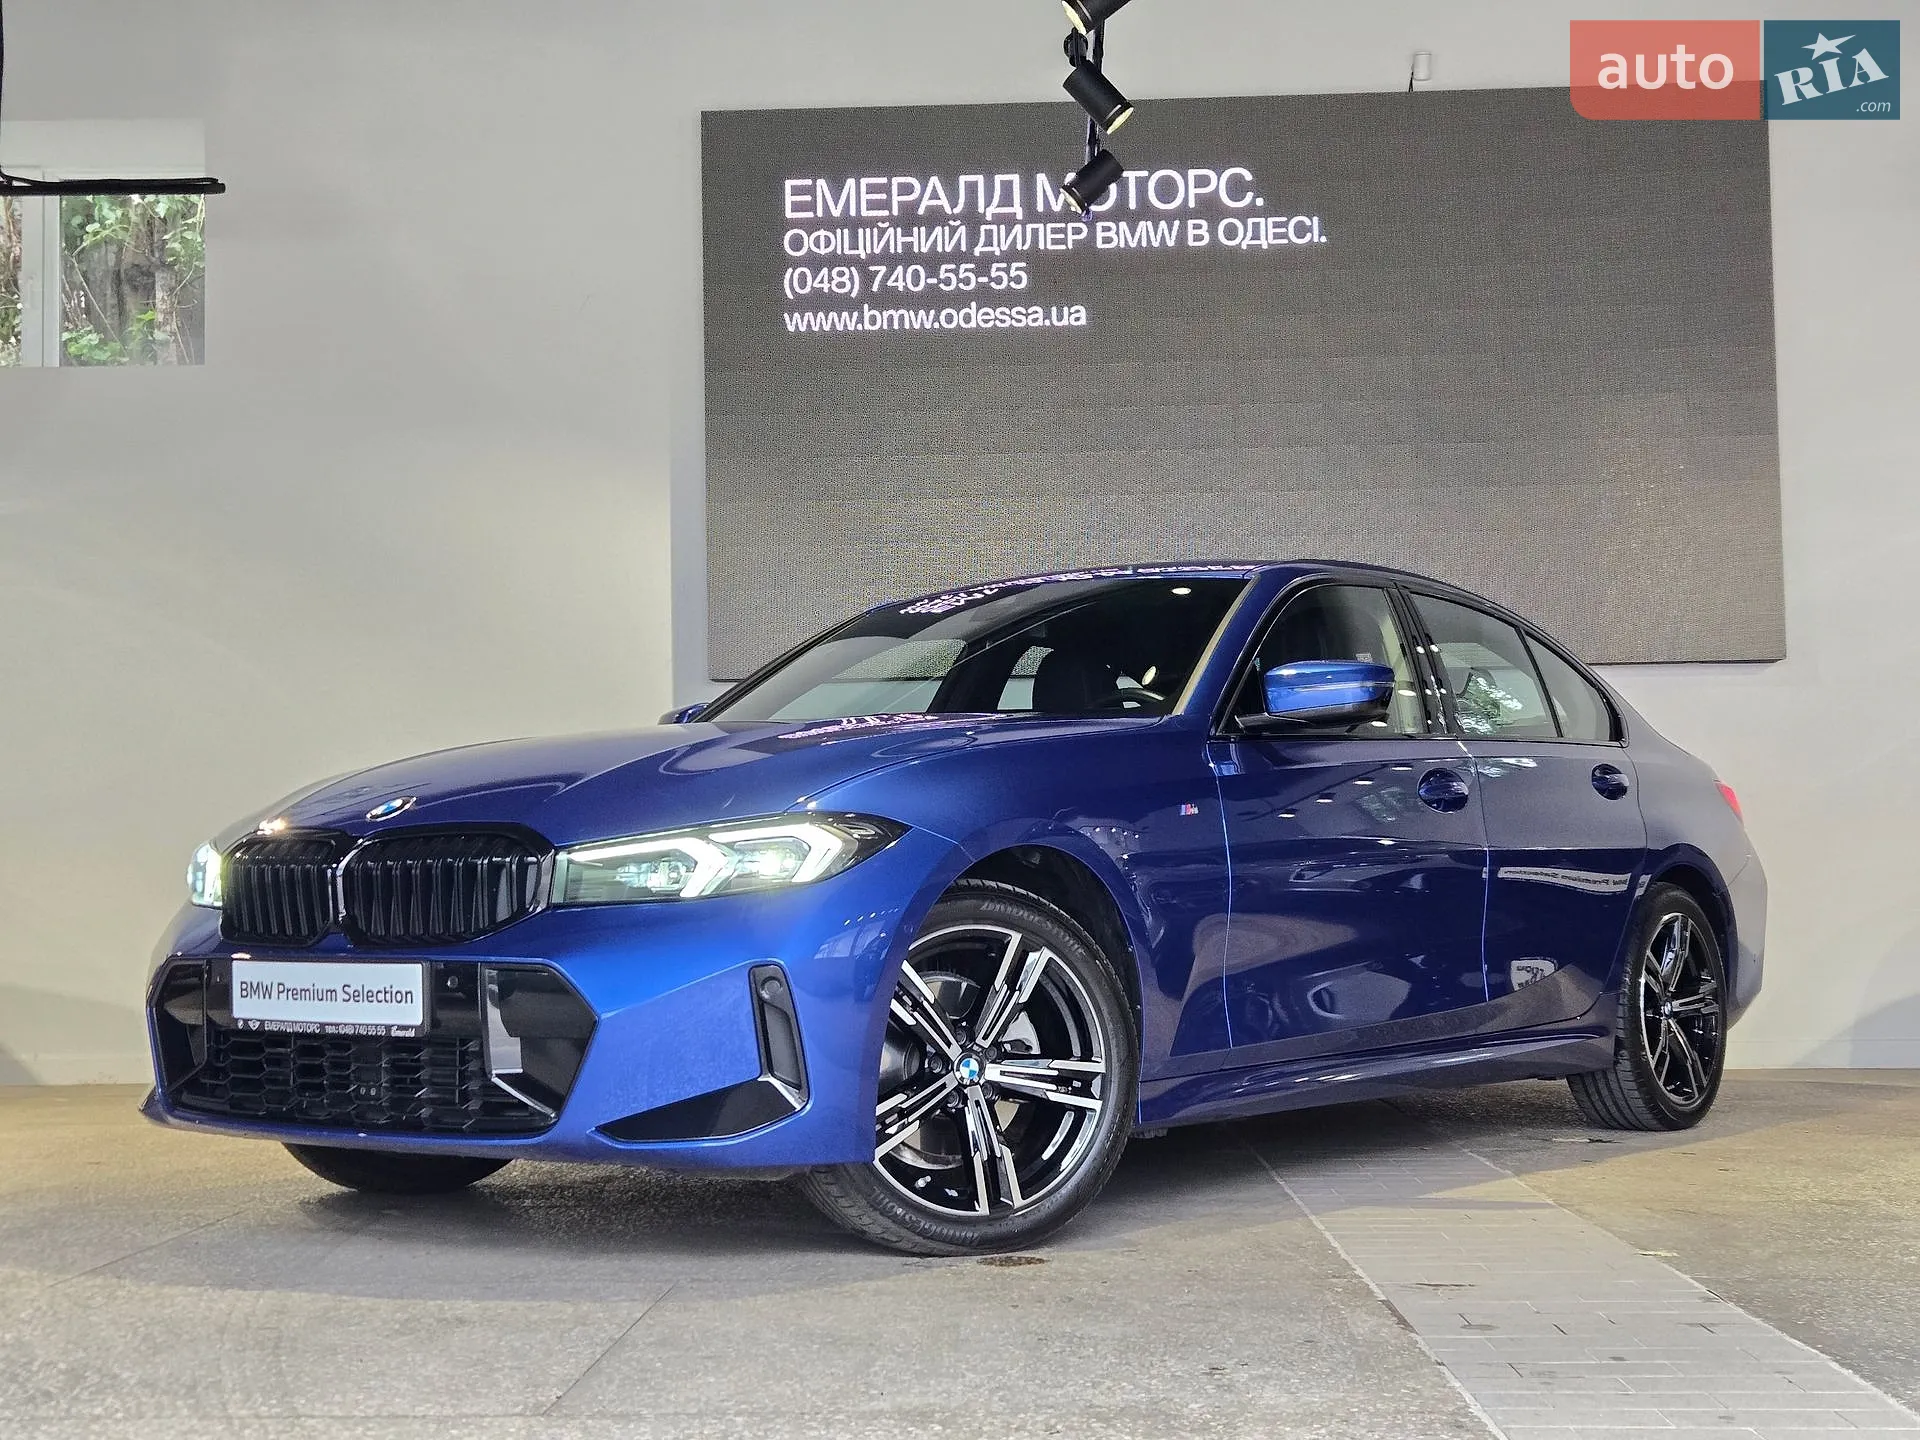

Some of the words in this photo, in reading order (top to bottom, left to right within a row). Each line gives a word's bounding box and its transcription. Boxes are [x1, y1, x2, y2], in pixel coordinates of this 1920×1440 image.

[784, 173, 1023, 220] ЕМЕРАЛД
[783, 221, 966, 259] ОФІЦІЙНИЙ
[974, 222, 1088, 256] ДИЛЕР
[1096, 220, 1180, 248] BMW
[1187, 219, 1210, 247] В
[1217, 215, 1328, 250] ОДЕСІ.
[783, 266, 860, 299] (048)
[868, 262, 1028, 292] 740-55-55
[783, 301, 1087, 332] www.bmw.odessa.ua
[239, 981, 273, 1000] BMW
[277, 982, 338, 1003] Premium
[342, 984, 414, 1004] Selection
